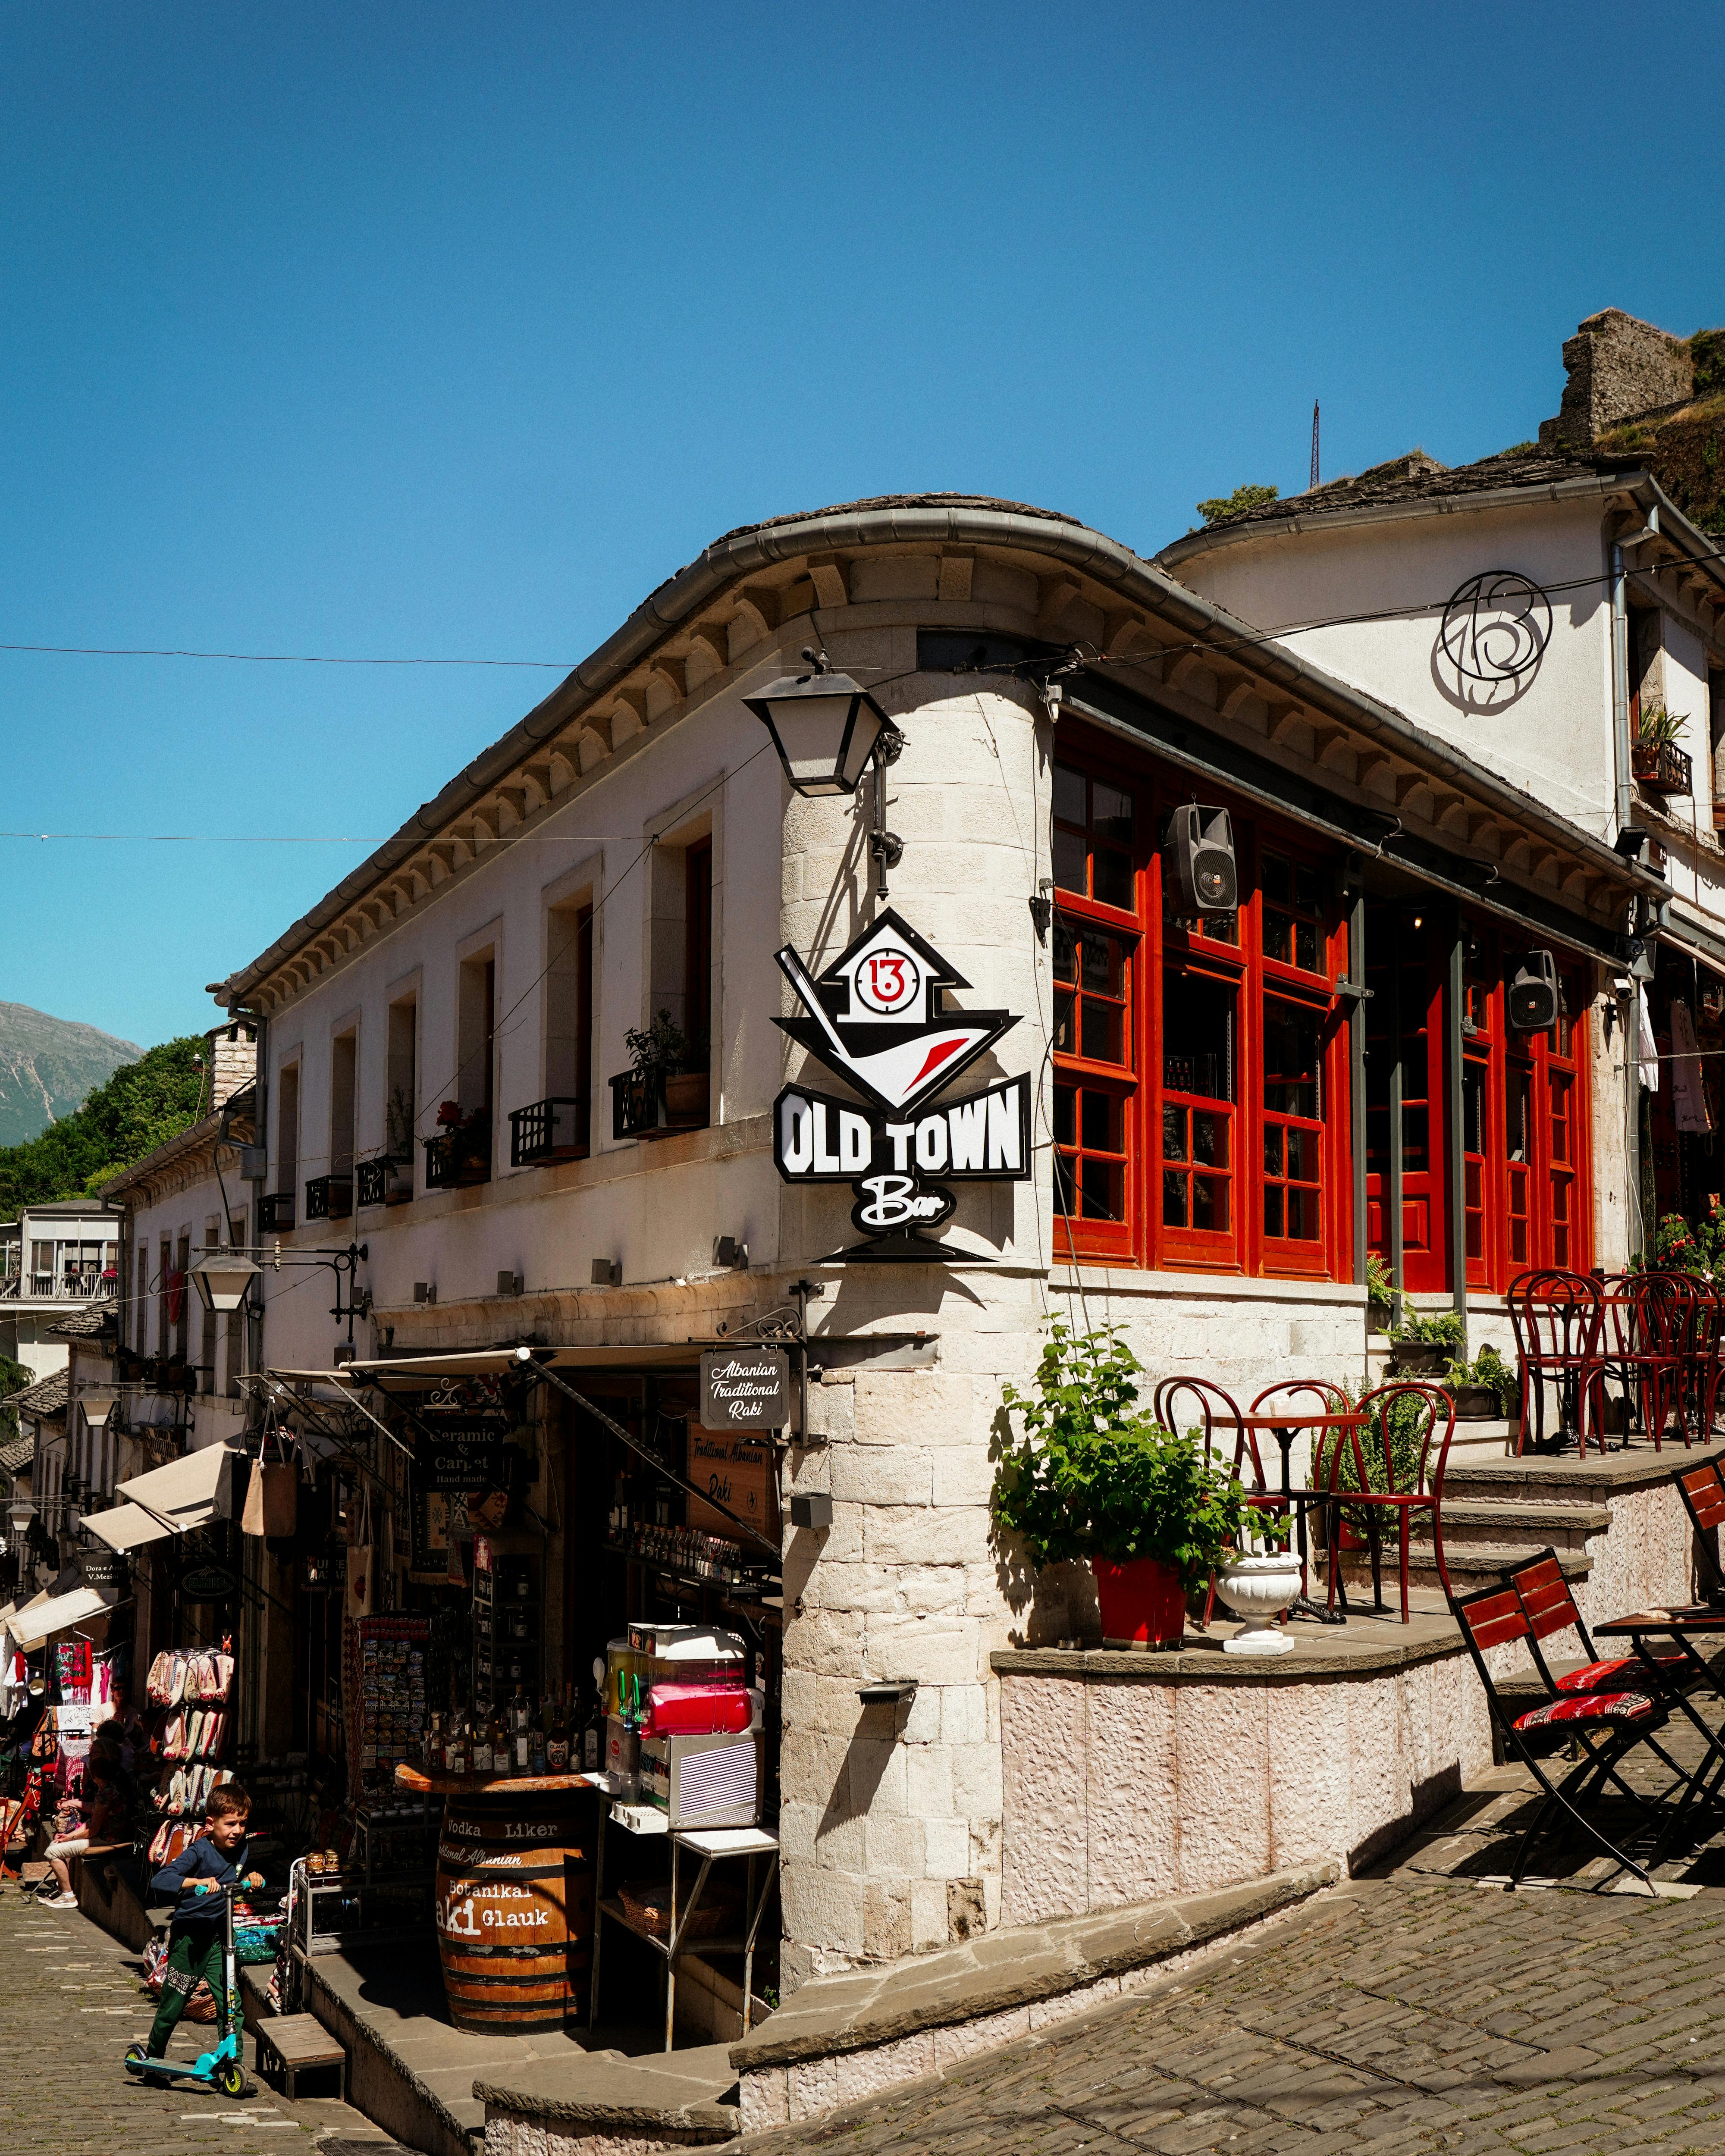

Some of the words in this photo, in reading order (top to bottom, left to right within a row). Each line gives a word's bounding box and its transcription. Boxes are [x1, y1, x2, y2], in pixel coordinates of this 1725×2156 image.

[869, 959, 905, 1002] 13
[781, 1093, 871, 1173] OLD
[886, 1084, 1020, 1171] TOWN
[861, 1175, 944, 1225] Bar
[712, 1360, 778, 1379] Albanian
[711, 1381, 779, 1399] Traditional
[729, 1401, 763, 1420] Raki
[430, 1429, 495, 1442] Ceramic
[455, 1444, 469, 1456] &
[694, 1437, 729, 1461] Traditional
[729, 1444, 763, 1465] Albanian
[436, 1475, 461, 1483] Hand
[463, 1475, 487, 1483] made
[448, 1819, 481, 1836] Vodka
[505, 1822, 558, 1838] Liker
[464, 1849, 522, 1865] Albanian
[449, 1880, 533, 1898] Botanikal
[482, 1908, 548, 1927] Glauk
